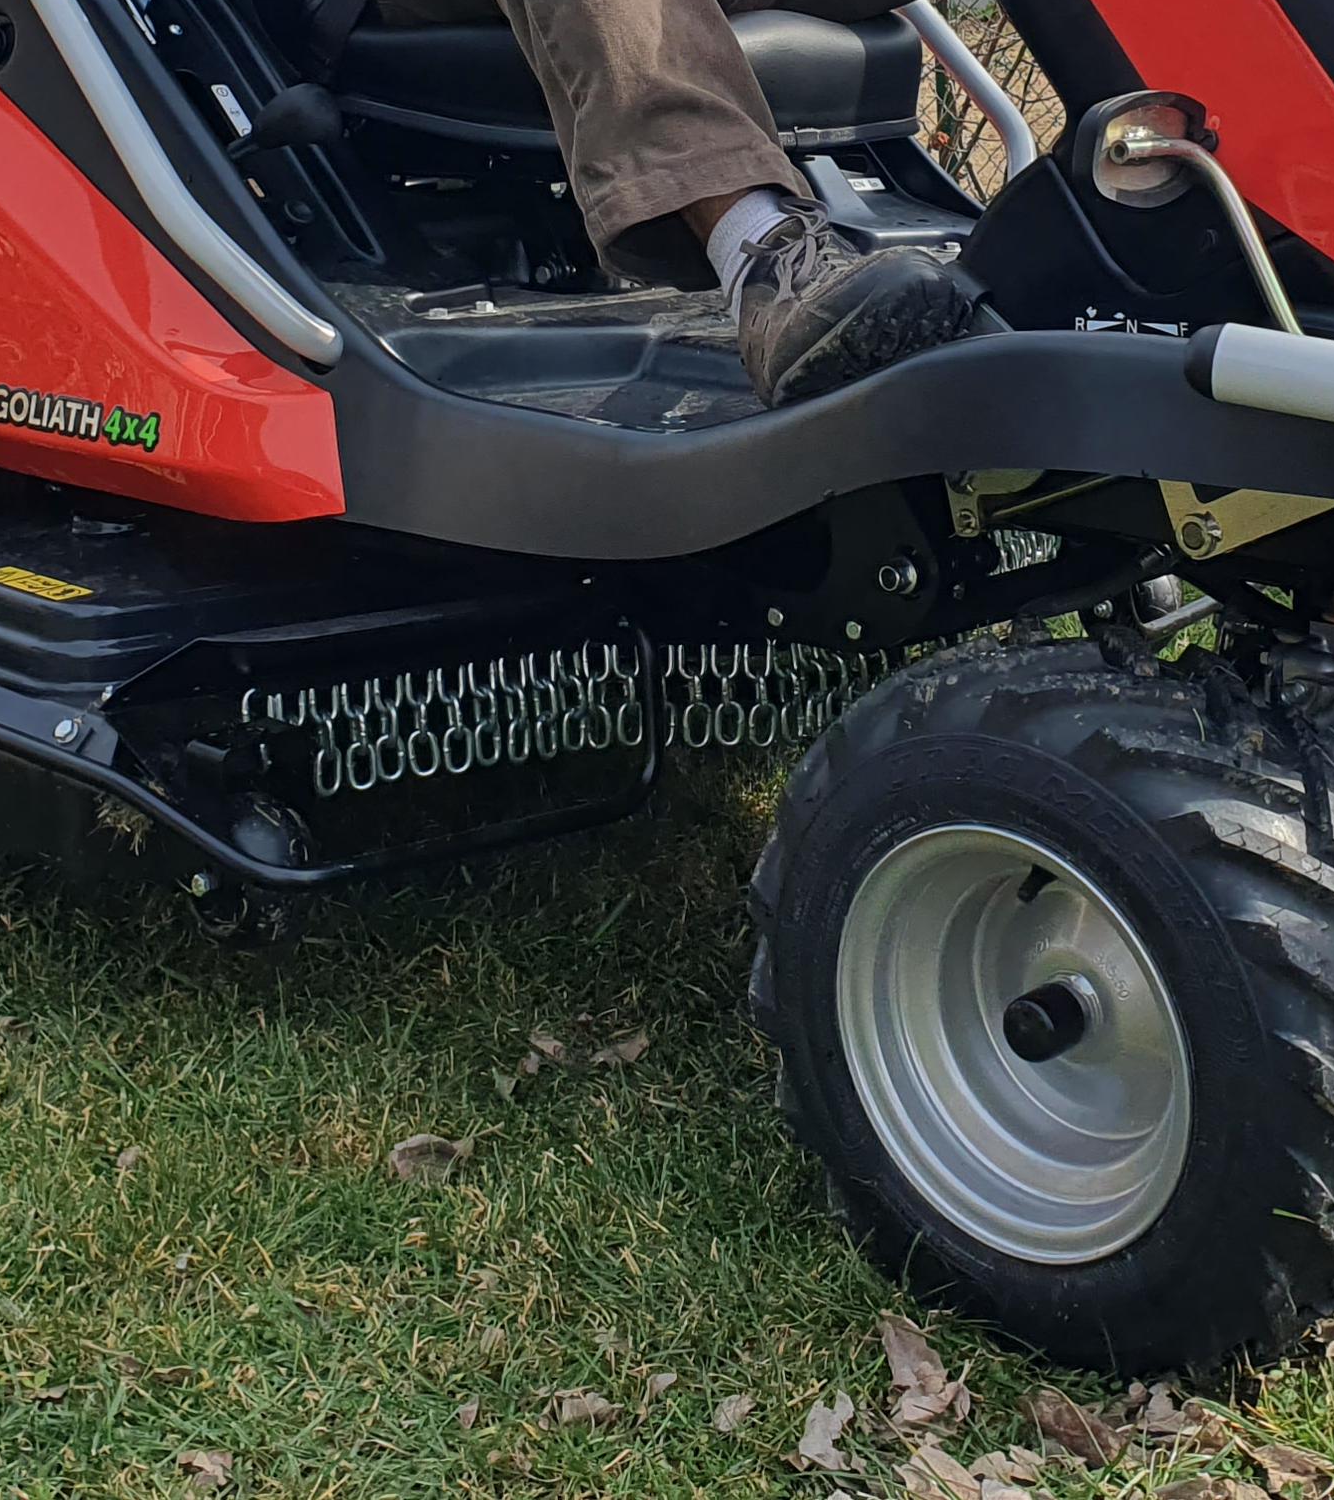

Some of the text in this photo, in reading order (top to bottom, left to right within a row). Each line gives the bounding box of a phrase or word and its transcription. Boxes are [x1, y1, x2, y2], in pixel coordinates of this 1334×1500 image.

[1075, 317, 1189, 337] R N F
[103, 408, 158, 448] 4x4
